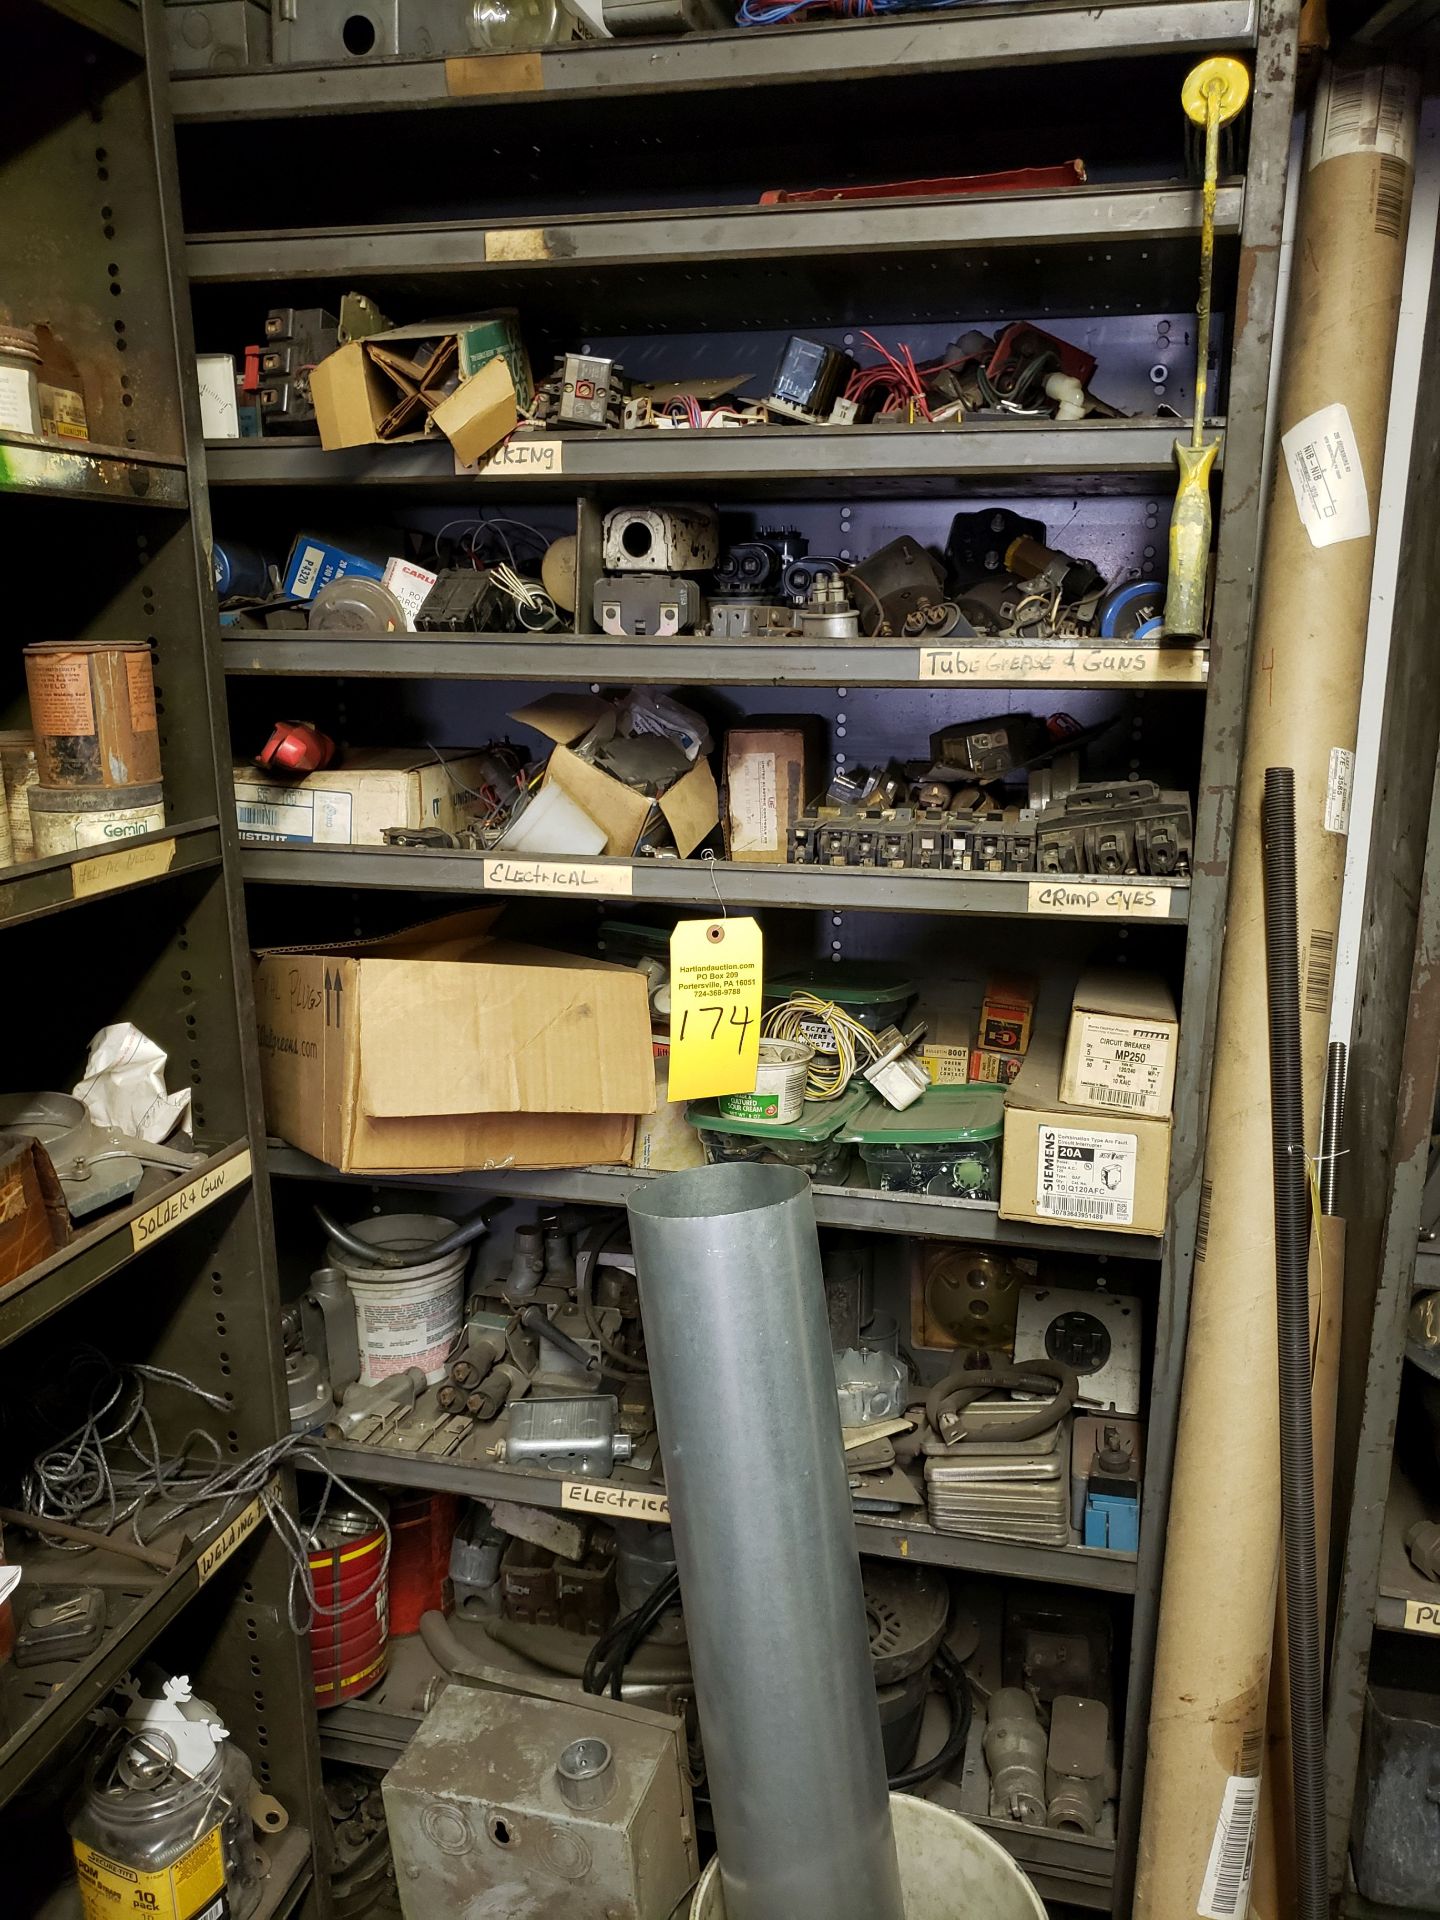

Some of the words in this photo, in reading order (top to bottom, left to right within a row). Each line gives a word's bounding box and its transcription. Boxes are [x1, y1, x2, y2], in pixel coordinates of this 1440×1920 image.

[297, 559, 314, 585] P4320
[103, 820, 148, 838] Gemini
[680, 963, 755, 973] Hartlandauction.com
[726, 971, 739, 979] 209
[678, 981, 722, 991] Portersville,
[723, 980, 734, 988] PA
[736, 978, 756, 987] 16051
[694, 988, 741, 998] 724-368-9788
[680, 1005, 755, 1056] 174
[1099, 1038, 1123, 1047] CIRCUIT
[1124, 1041, 1151, 1050] BREAKER
[947, 1049, 967, 1057] 800T
[1115, 1050, 1146, 1063] MP250
[727, 1103, 742, 1111] SOUR
[730, 1098, 758, 1107] CULTURED
[1060, 1148, 1082, 1158] 20A
[1043, 1132, 1055, 1191] SIEMENS
[1068, 1185, 1105, 1195] Q120AFC
[134, 1890, 156, 1904] 10
[133, 1901, 160, 1911] pack
